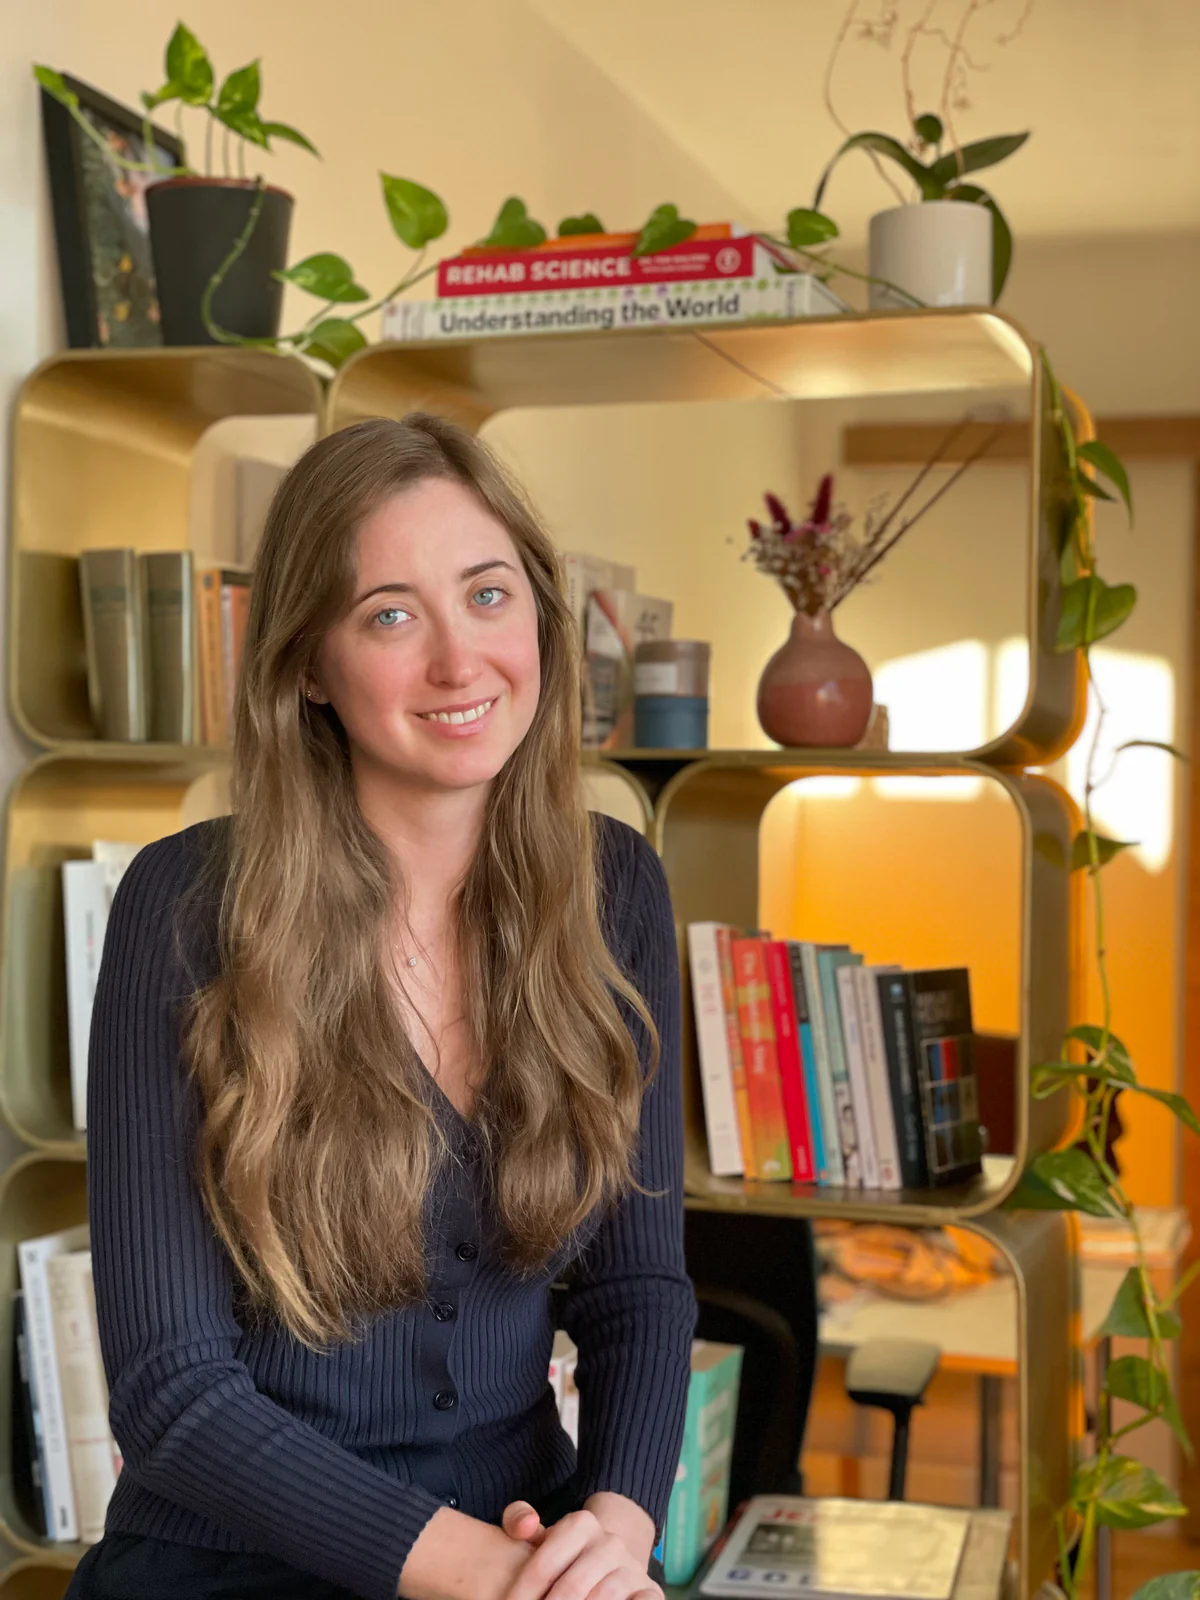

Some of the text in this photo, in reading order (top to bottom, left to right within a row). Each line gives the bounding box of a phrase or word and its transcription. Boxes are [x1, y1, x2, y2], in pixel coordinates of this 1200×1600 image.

[446, 262, 526, 285] REHAB
[530, 256, 632, 281] SCIENCE
[440, 294, 740, 333] Understanding the World
